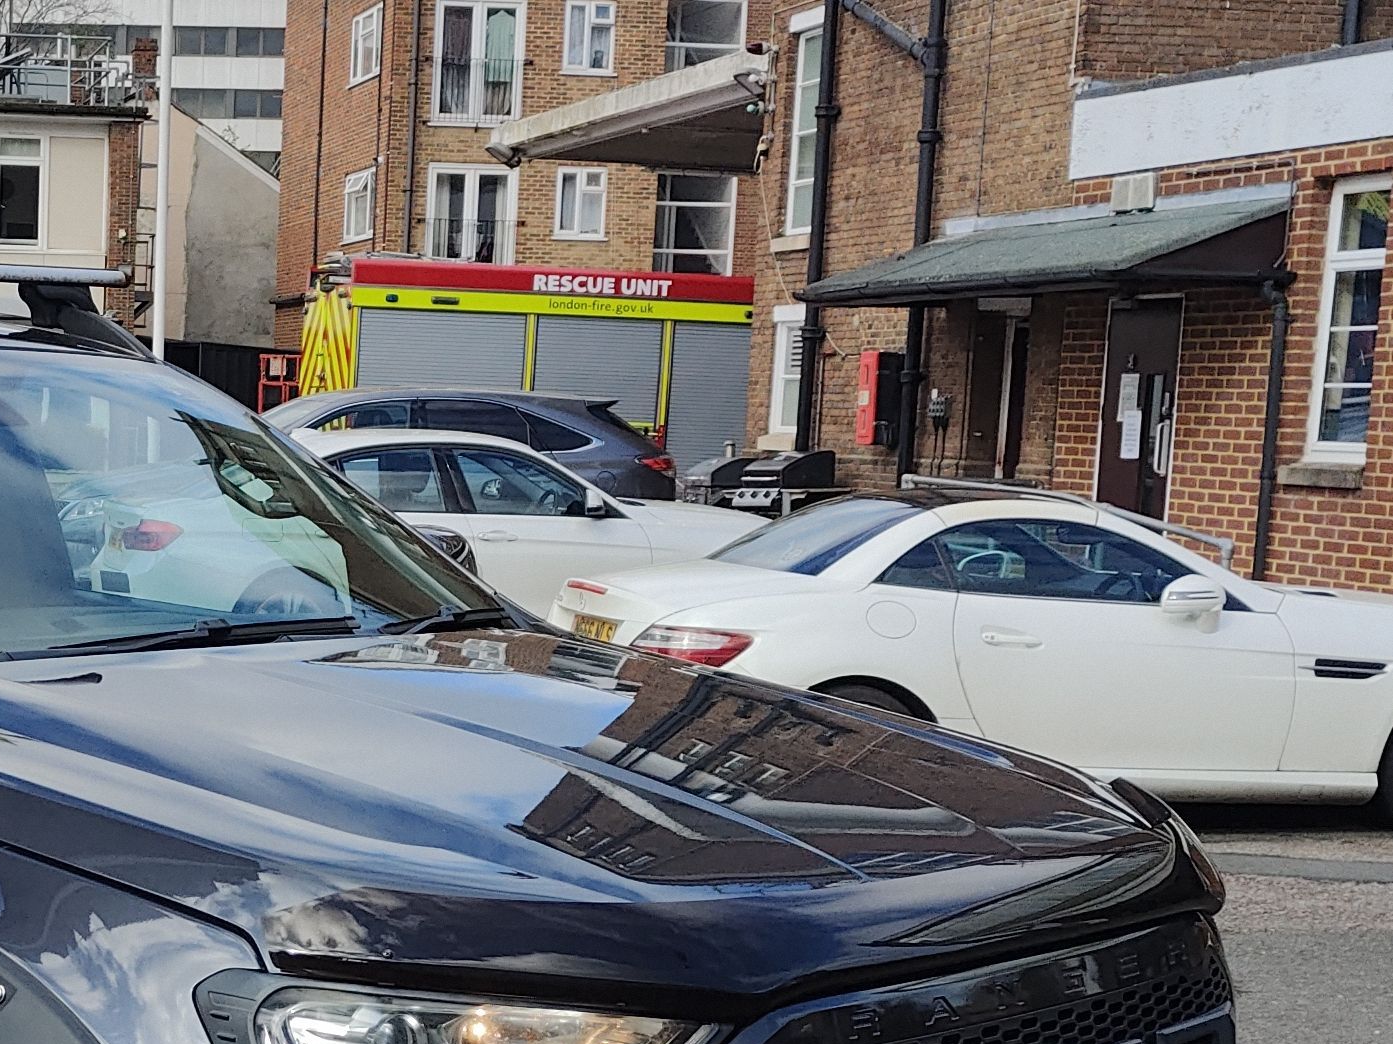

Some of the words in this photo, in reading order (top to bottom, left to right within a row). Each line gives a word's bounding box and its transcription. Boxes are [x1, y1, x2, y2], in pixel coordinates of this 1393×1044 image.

[532, 273, 616, 294] RESCUE
[620, 277, 673, 297] UNIT
[548, 298, 654, 315] london-fire.gov.uk
[848, 941, 1191, 1040] RANGER
